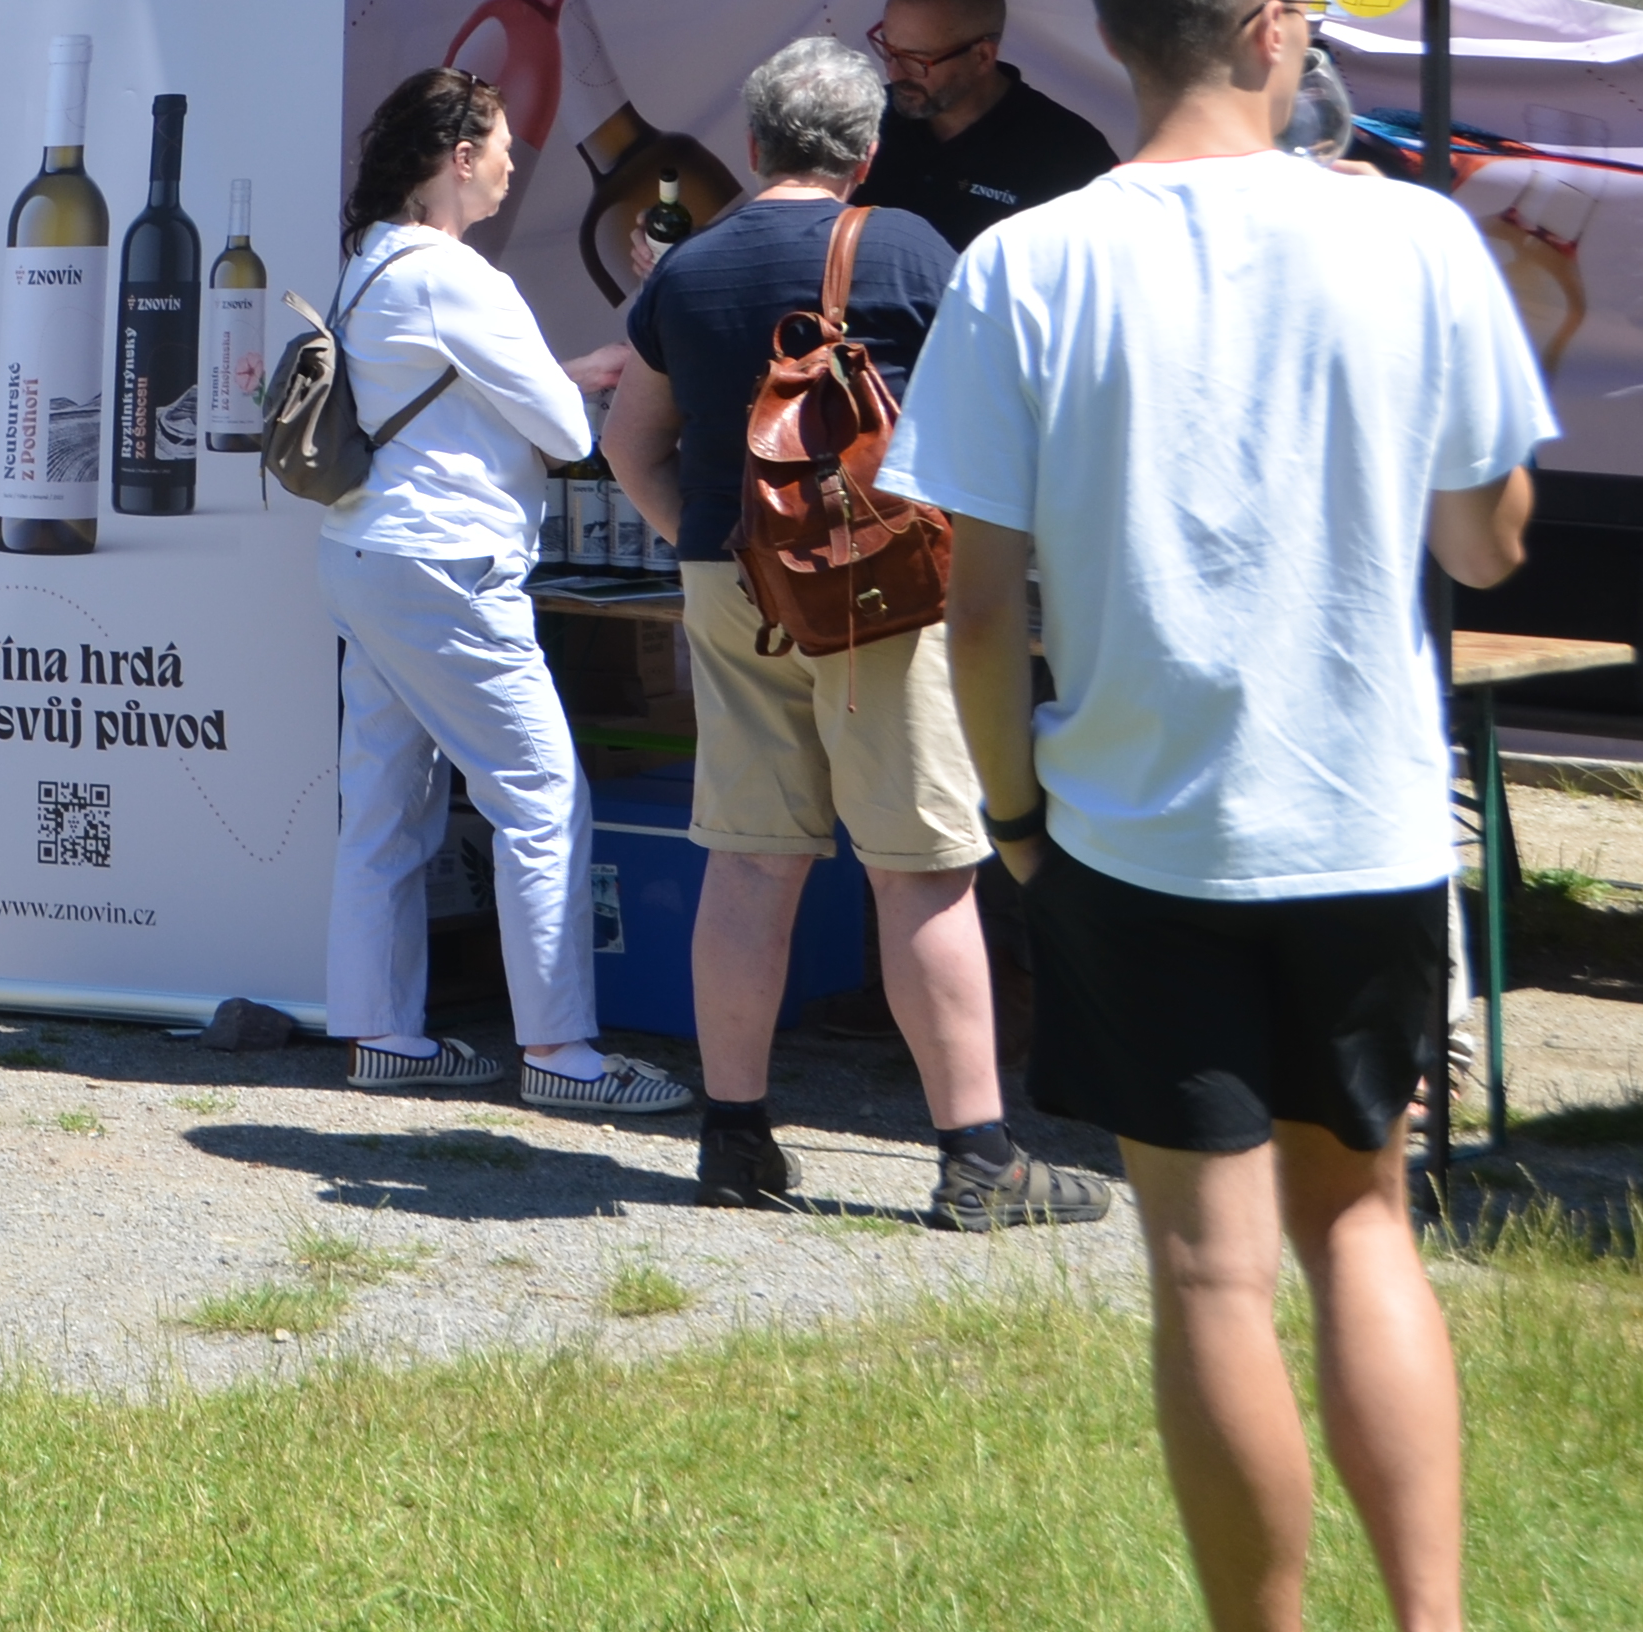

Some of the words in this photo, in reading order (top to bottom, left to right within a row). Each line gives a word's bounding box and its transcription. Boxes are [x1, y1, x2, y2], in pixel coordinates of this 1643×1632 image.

[969, 183, 1018, 205] ZNOVÍN
[27, 264, 83, 286] ZNOVÍN
[137, 294, 182, 311] ZNOVÍN
[79, 640, 184, 688] hrdá
[94, 699, 229, 752] původ
